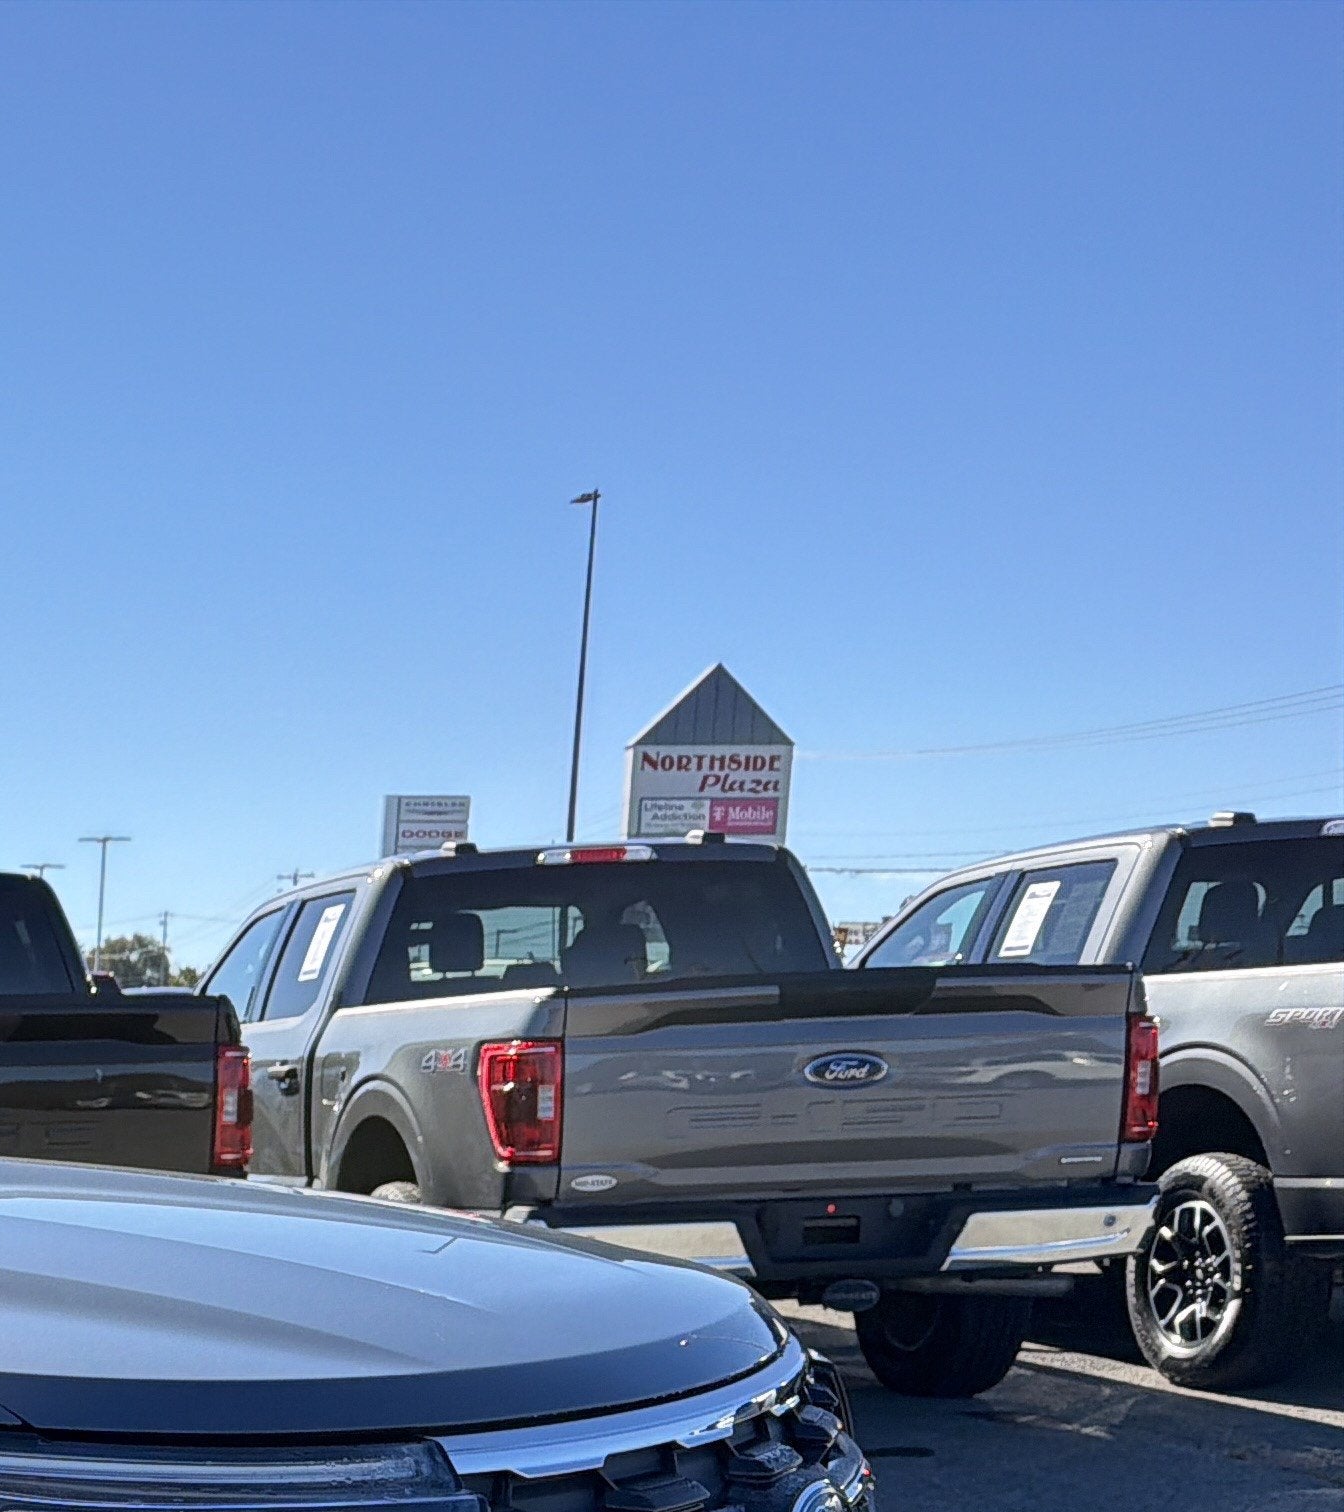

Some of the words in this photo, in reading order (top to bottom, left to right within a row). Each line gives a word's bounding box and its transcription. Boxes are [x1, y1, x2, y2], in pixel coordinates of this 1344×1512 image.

[640, 751, 782, 772] NORTHSIDE
[698, 773, 780, 793] Plaza
[824, 1060, 871, 1080] Ford
